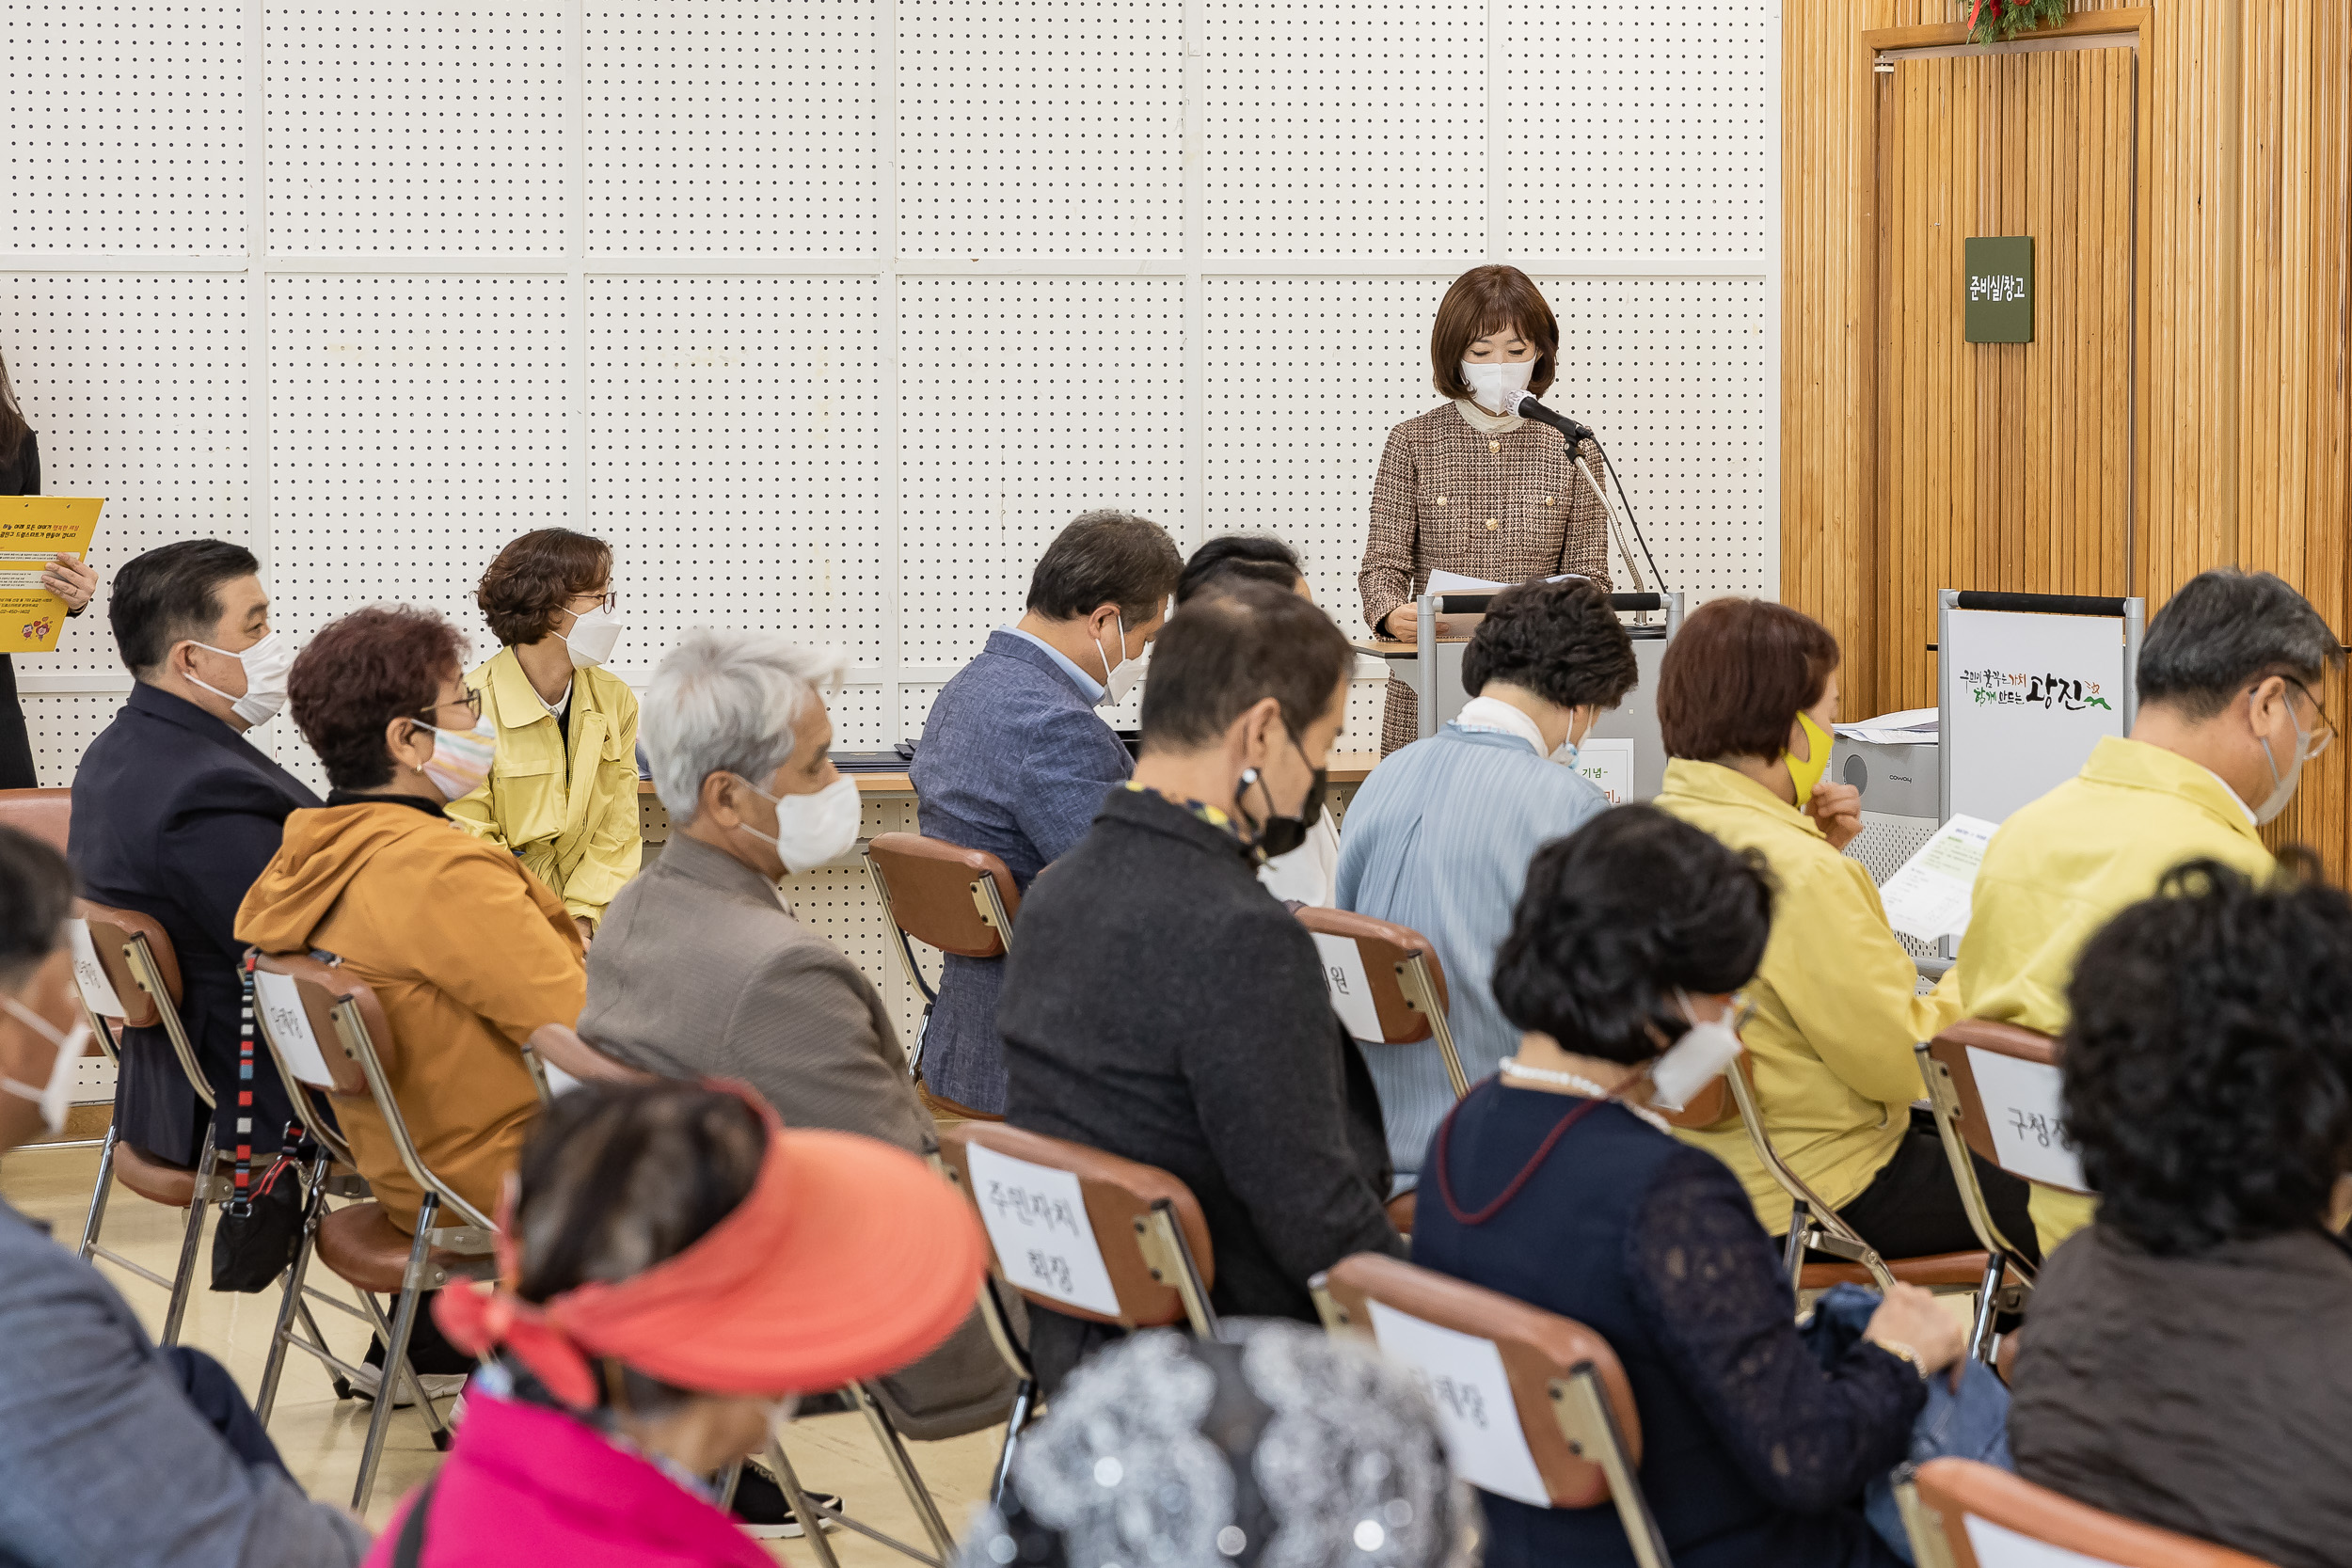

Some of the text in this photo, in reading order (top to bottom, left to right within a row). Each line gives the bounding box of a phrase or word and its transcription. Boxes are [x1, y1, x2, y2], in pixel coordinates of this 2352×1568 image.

[1969, 275, 2026, 302] 준비실/창고
[1960, 669, 2026, 694] 구민이 꿈꾸는 가치
[2026, 673, 2086, 710] 광진
[1973, 687, 2026, 707] 함께 만드는
[1888, 774, 1913, 784] coway
[988, 1180, 1080, 1238] 주민자치
[1026, 1248, 1074, 1295] 회장
